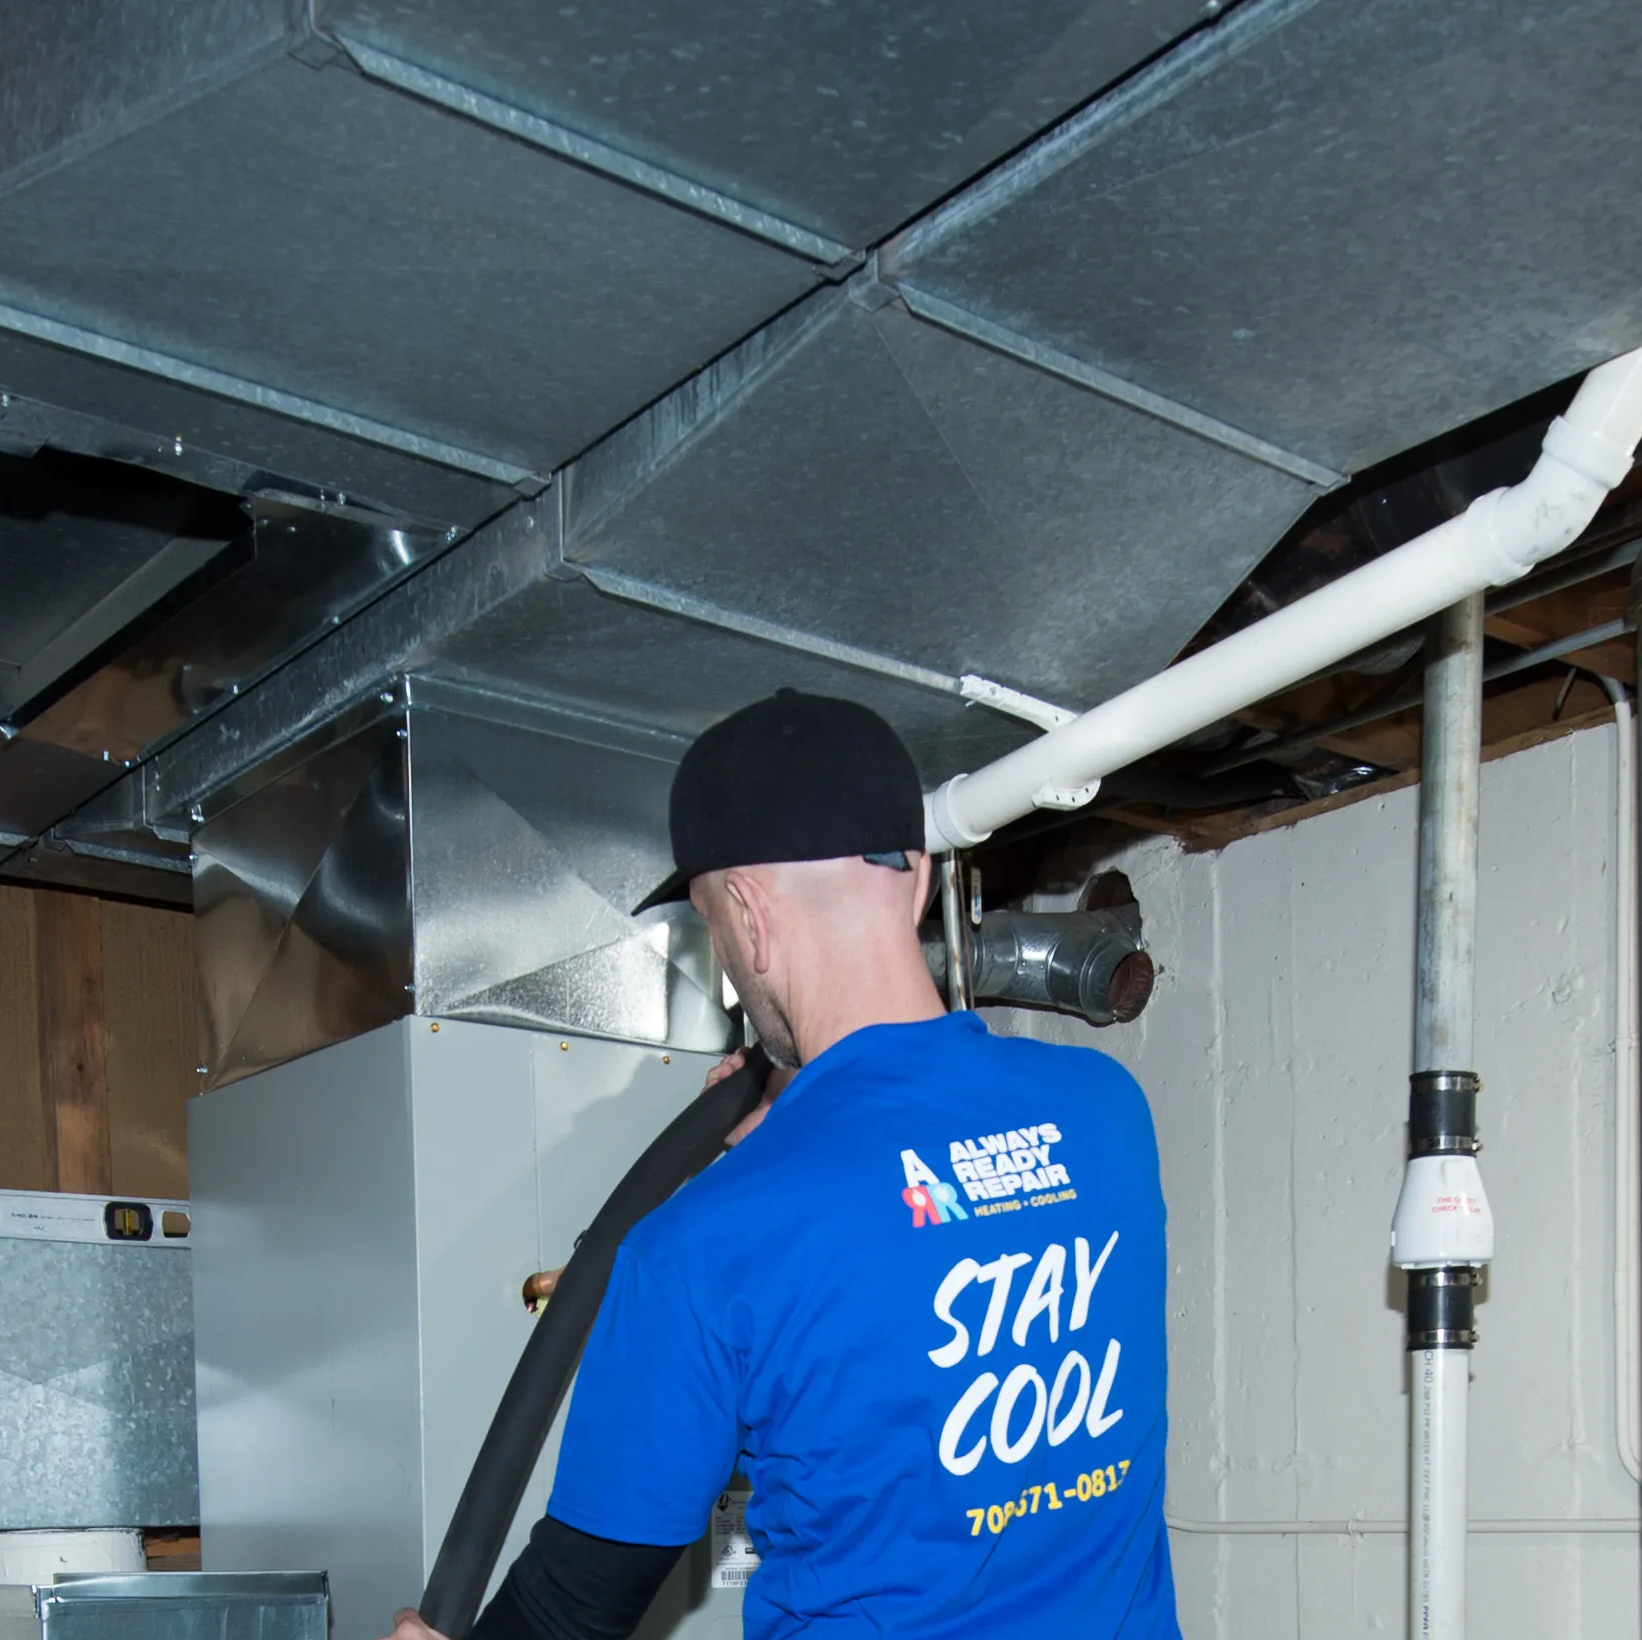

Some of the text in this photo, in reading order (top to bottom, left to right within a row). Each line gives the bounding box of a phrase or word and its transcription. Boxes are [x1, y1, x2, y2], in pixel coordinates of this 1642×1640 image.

[949, 1122, 1063, 1163] ALWAYS
[952, 1144, 1051, 1183] READY
[962, 1163, 1071, 1202] REPAIR
[973, 1199, 1022, 1217] HEATING
[1029, 1188, 1078, 1207] COOLING
[927, 1230, 1119, 1369] STAY
[1424, 1368, 1435, 1383] 40
[938, 1338, 1124, 1476] COOL
